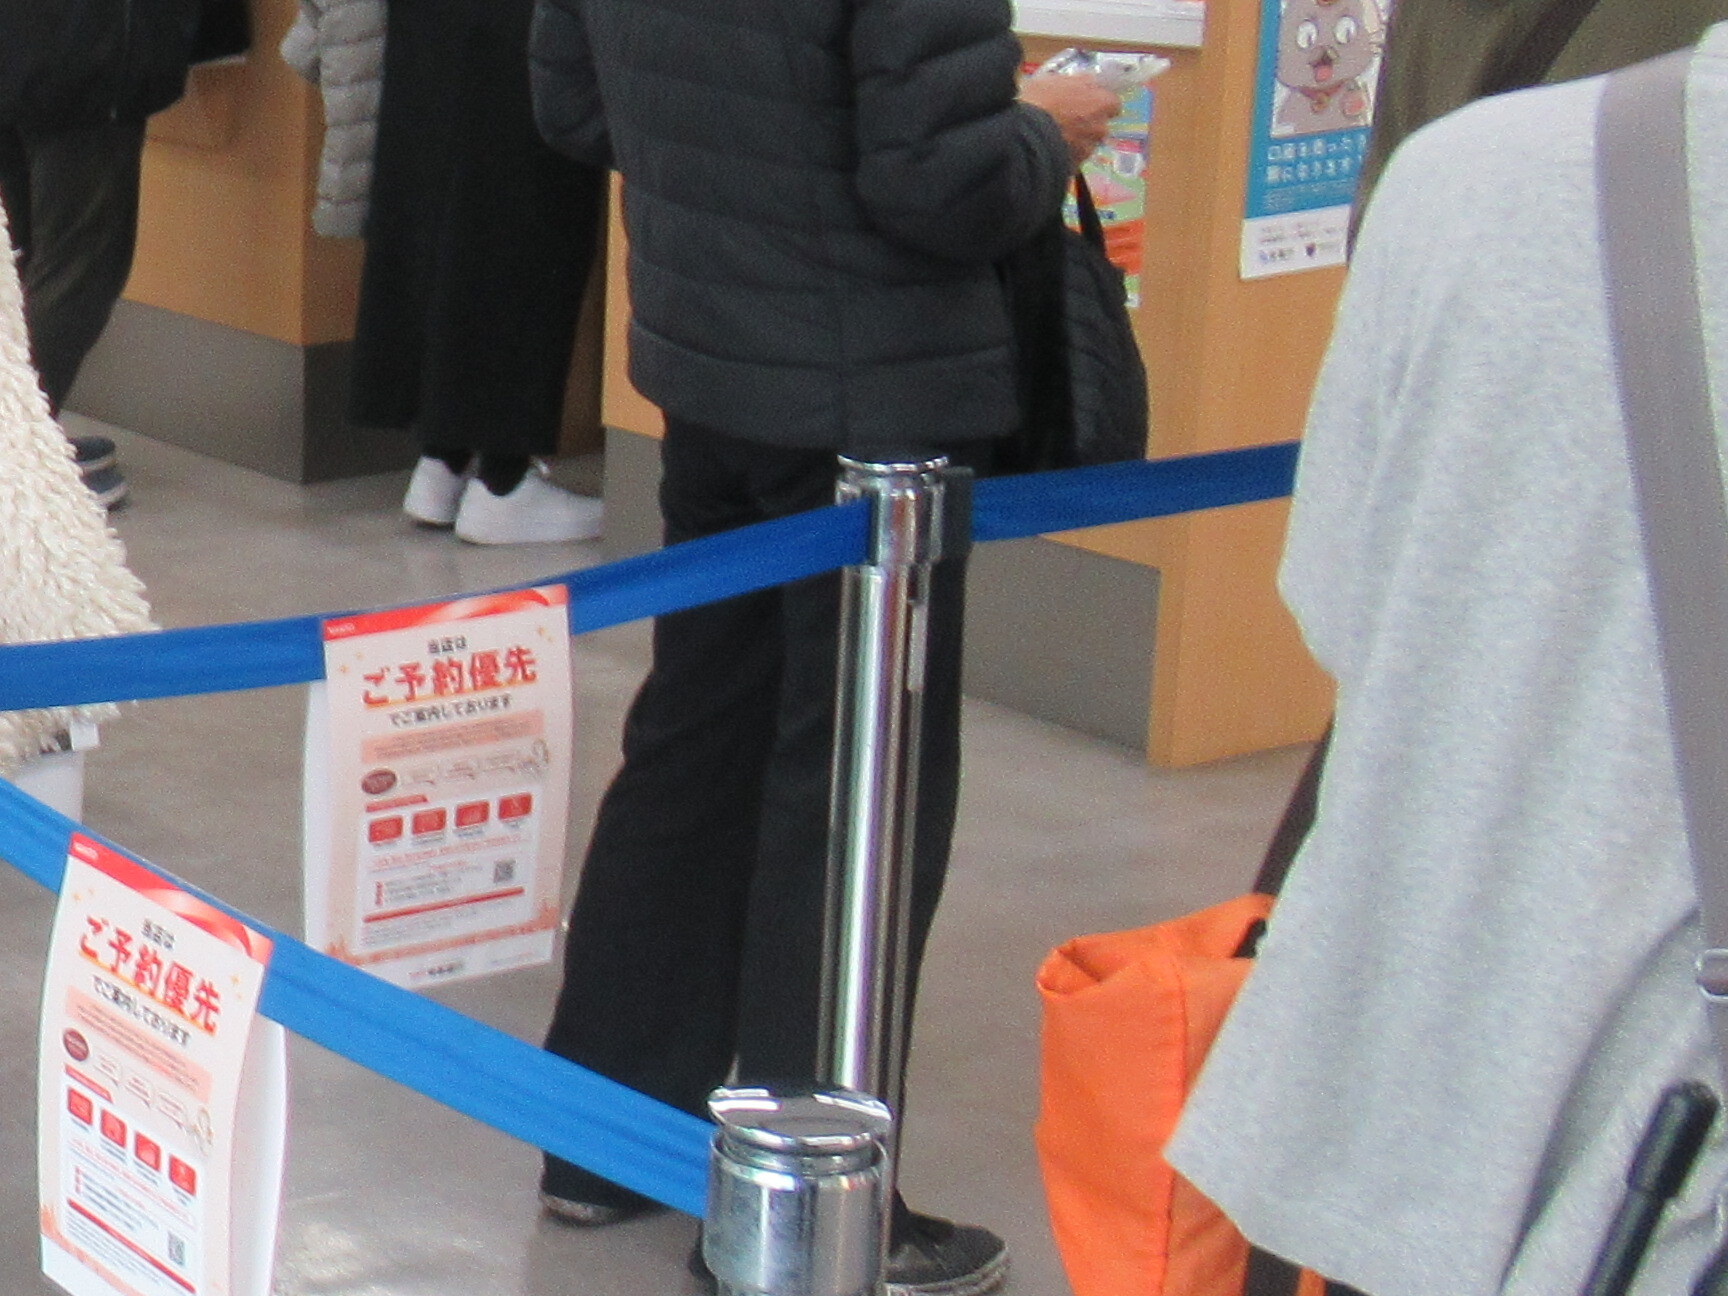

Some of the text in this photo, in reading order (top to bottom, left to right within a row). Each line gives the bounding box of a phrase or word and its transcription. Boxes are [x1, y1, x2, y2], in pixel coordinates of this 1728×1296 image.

[362, 645, 538, 706] ご予約優先
[389, 694, 512, 728] でご案内しております
[79, 914, 222, 1034] ご予約優先
